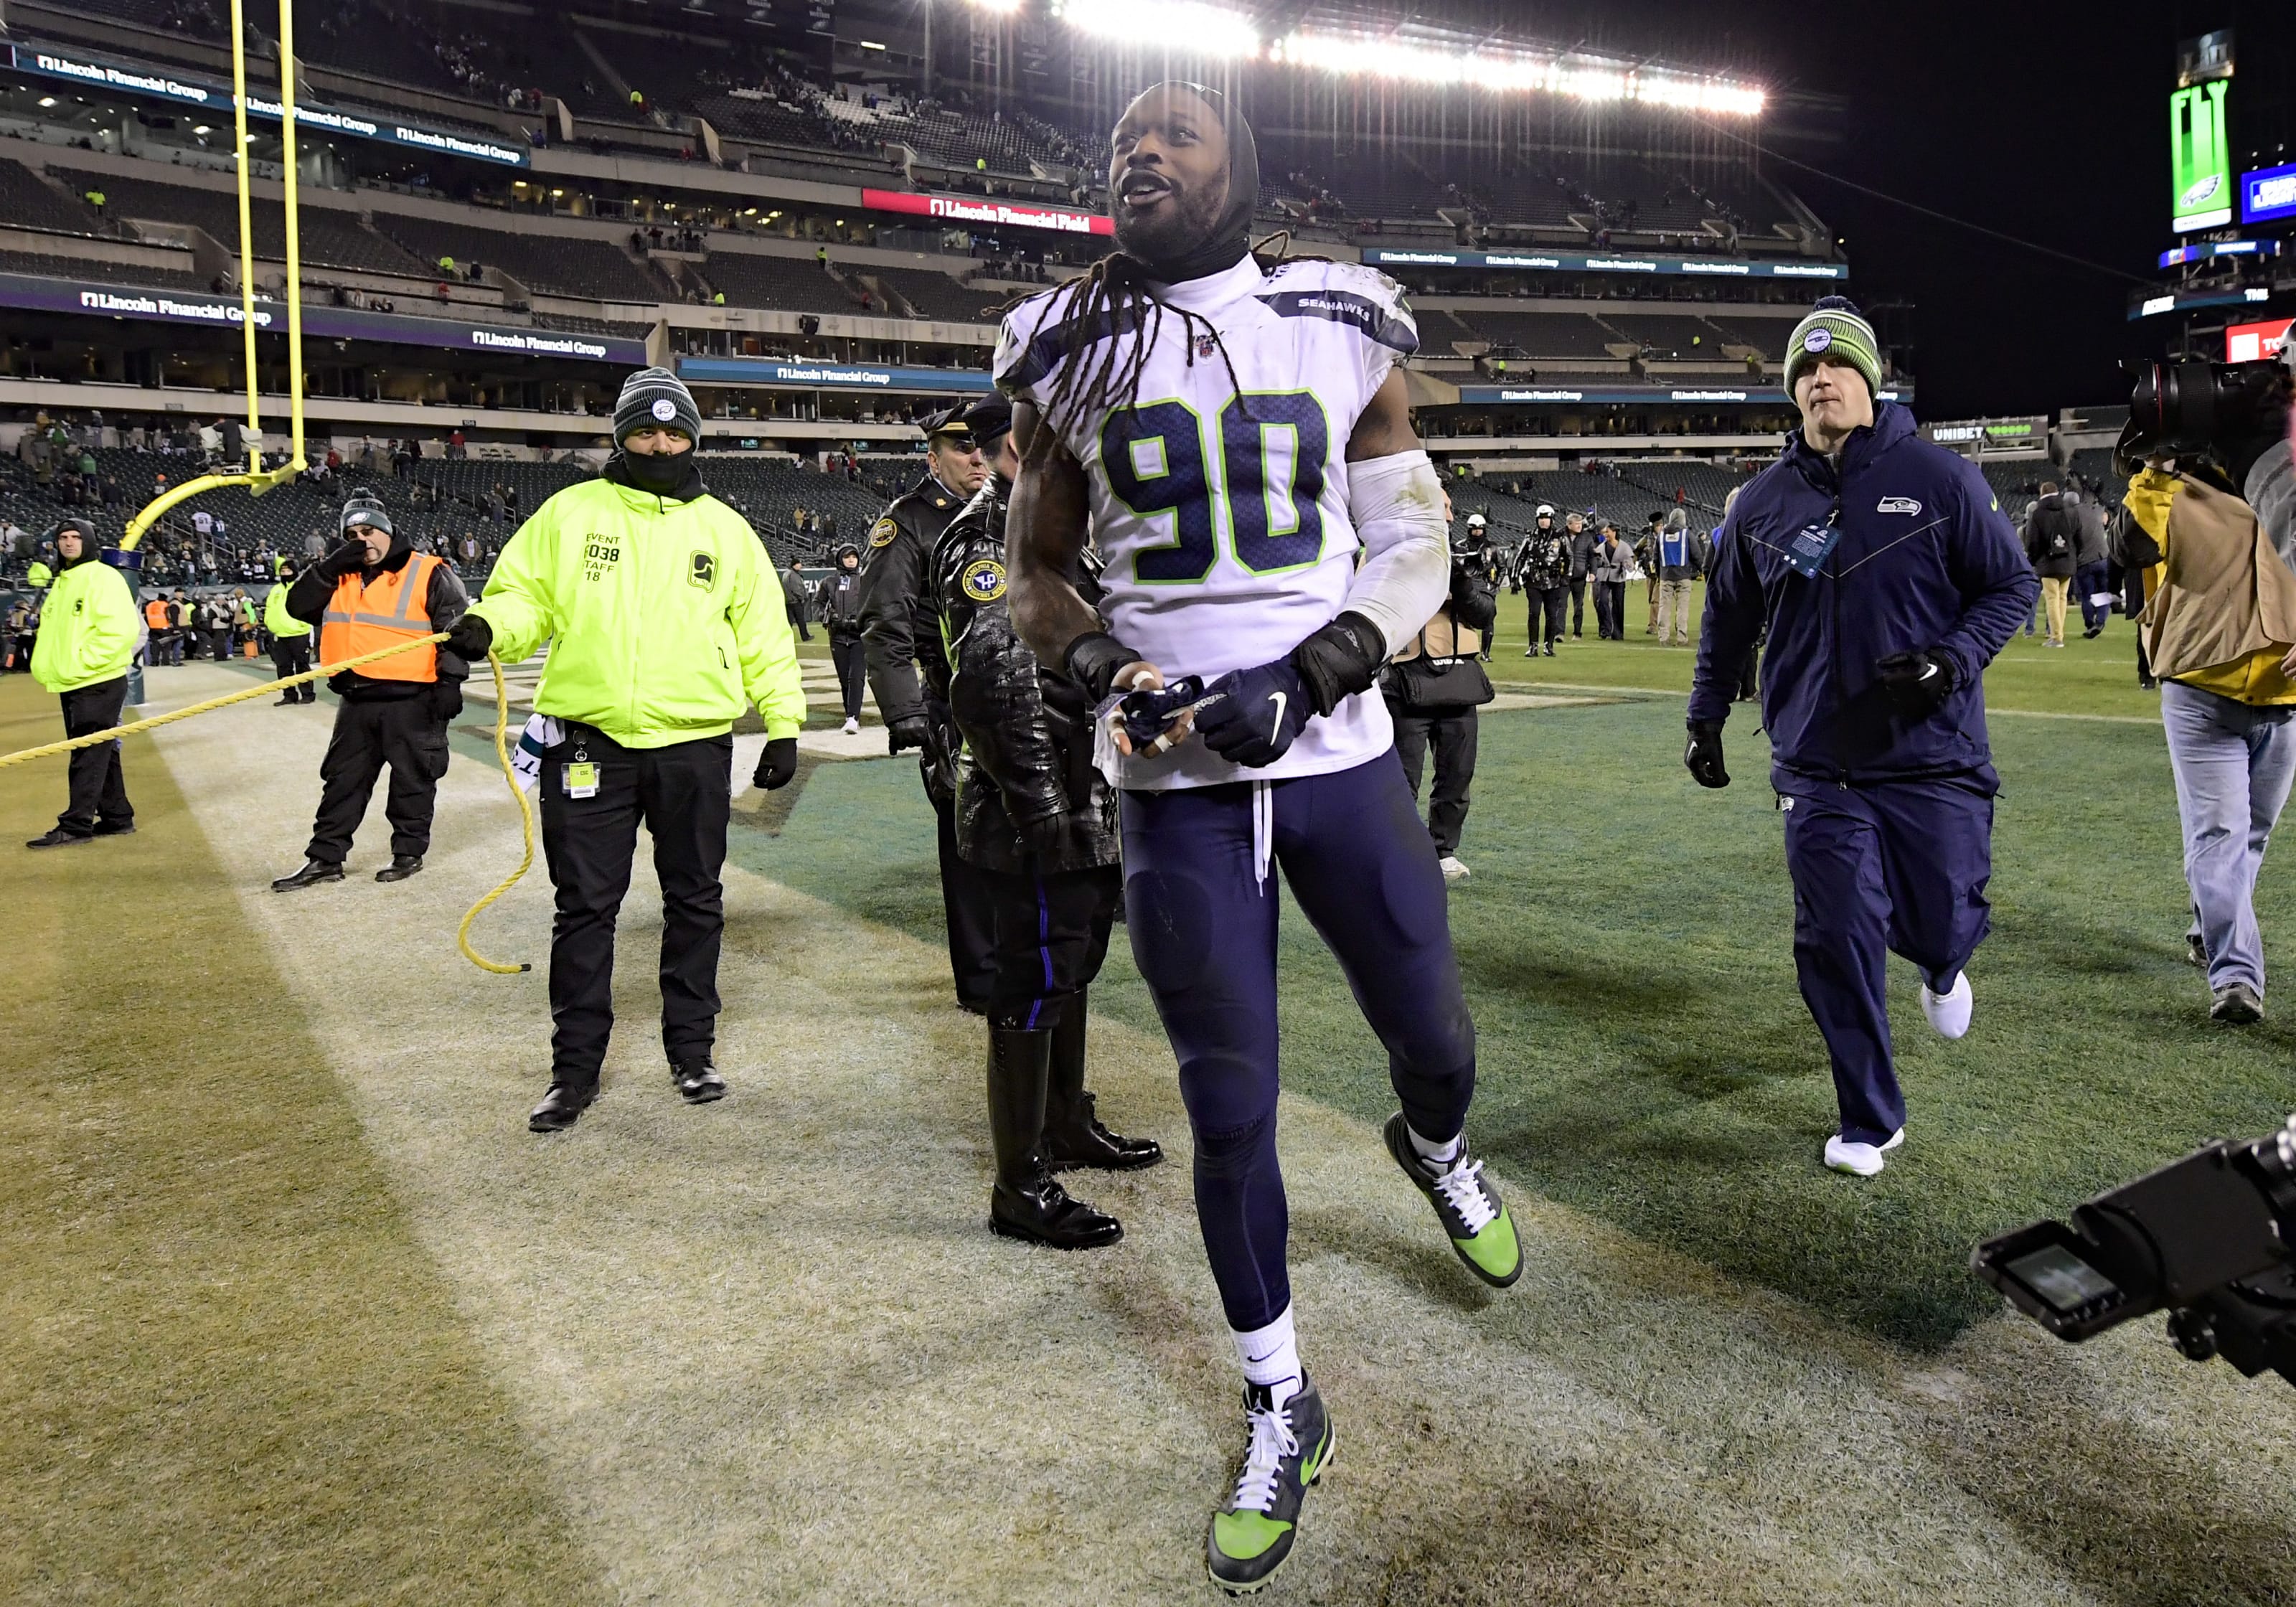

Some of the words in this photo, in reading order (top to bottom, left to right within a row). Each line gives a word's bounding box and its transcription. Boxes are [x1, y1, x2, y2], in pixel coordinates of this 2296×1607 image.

[54, 57, 107, 81] Lincoln
[106, 69, 166, 93] Financial
[166, 81, 208, 103] Group
[293, 105, 342, 128] Financial
[342, 117, 377, 136] Group
[409, 129, 446, 148] Lincoln
[446, 137, 489, 157] Financial
[490, 146, 520, 164] Group
[945, 200, 997, 222] Lincoln
[997, 207, 1058, 229] Financial
[1058, 215, 1090, 232] Field
[99, 294, 157, 314] Lincoln
[158, 299, 225, 319] Financial
[226, 306, 272, 326] Grup
[1297, 298, 1370, 322] SEAHAWKS
[486, 333, 525, 349] Lincoln
[526, 336, 573, 353] Financial
[574, 342, 606, 358] Group
[788, 369, 821, 380] Lincoln
[822, 370, 862, 382] Financial
[862, 372, 890, 385] Group
[1509, 391, 1533, 400] Lincoln
[1533, 391, 1562, 400] Financial
[1562, 391, 1583, 401] Group
[1933, 426, 1984, 441] UNIBET
[1098, 387, 1330, 585] 90
[586, 533, 621, 545] EVENT
[583, 560, 615, 572] TAFF
[585, 570, 601, 582] 18
